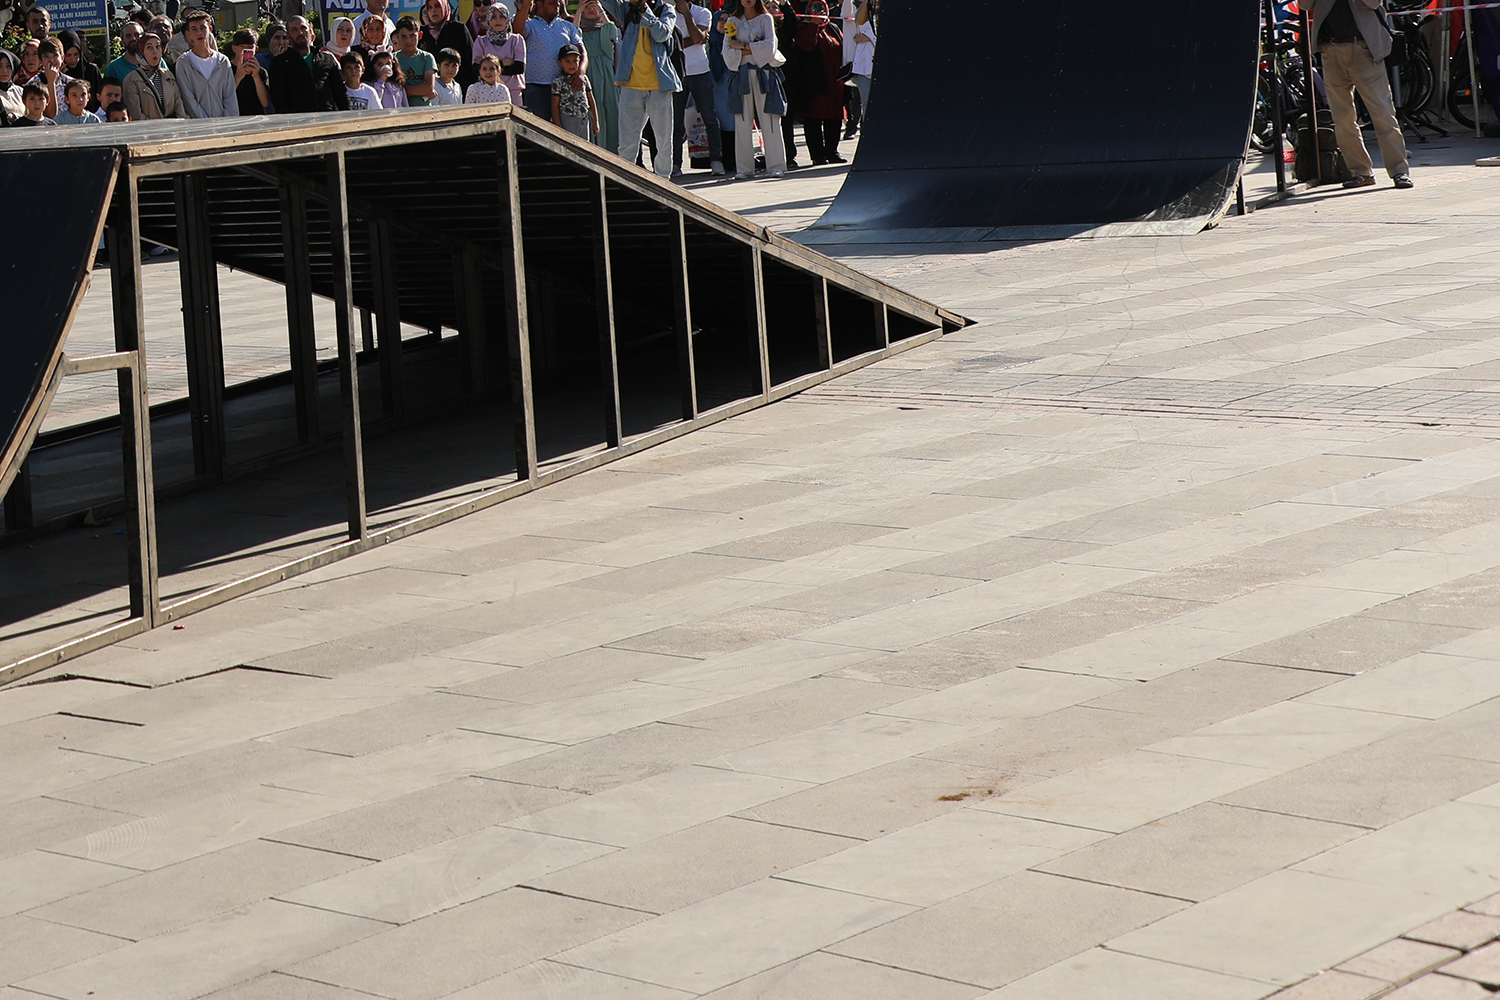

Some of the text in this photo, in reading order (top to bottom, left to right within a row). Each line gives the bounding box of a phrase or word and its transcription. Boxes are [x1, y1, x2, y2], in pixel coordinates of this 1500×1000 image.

[58, 2, 70, 11] İÇİN
[69, 1, 96, 10] YAŞATILAN
[74, 10, 97, 18] KABUKLU
